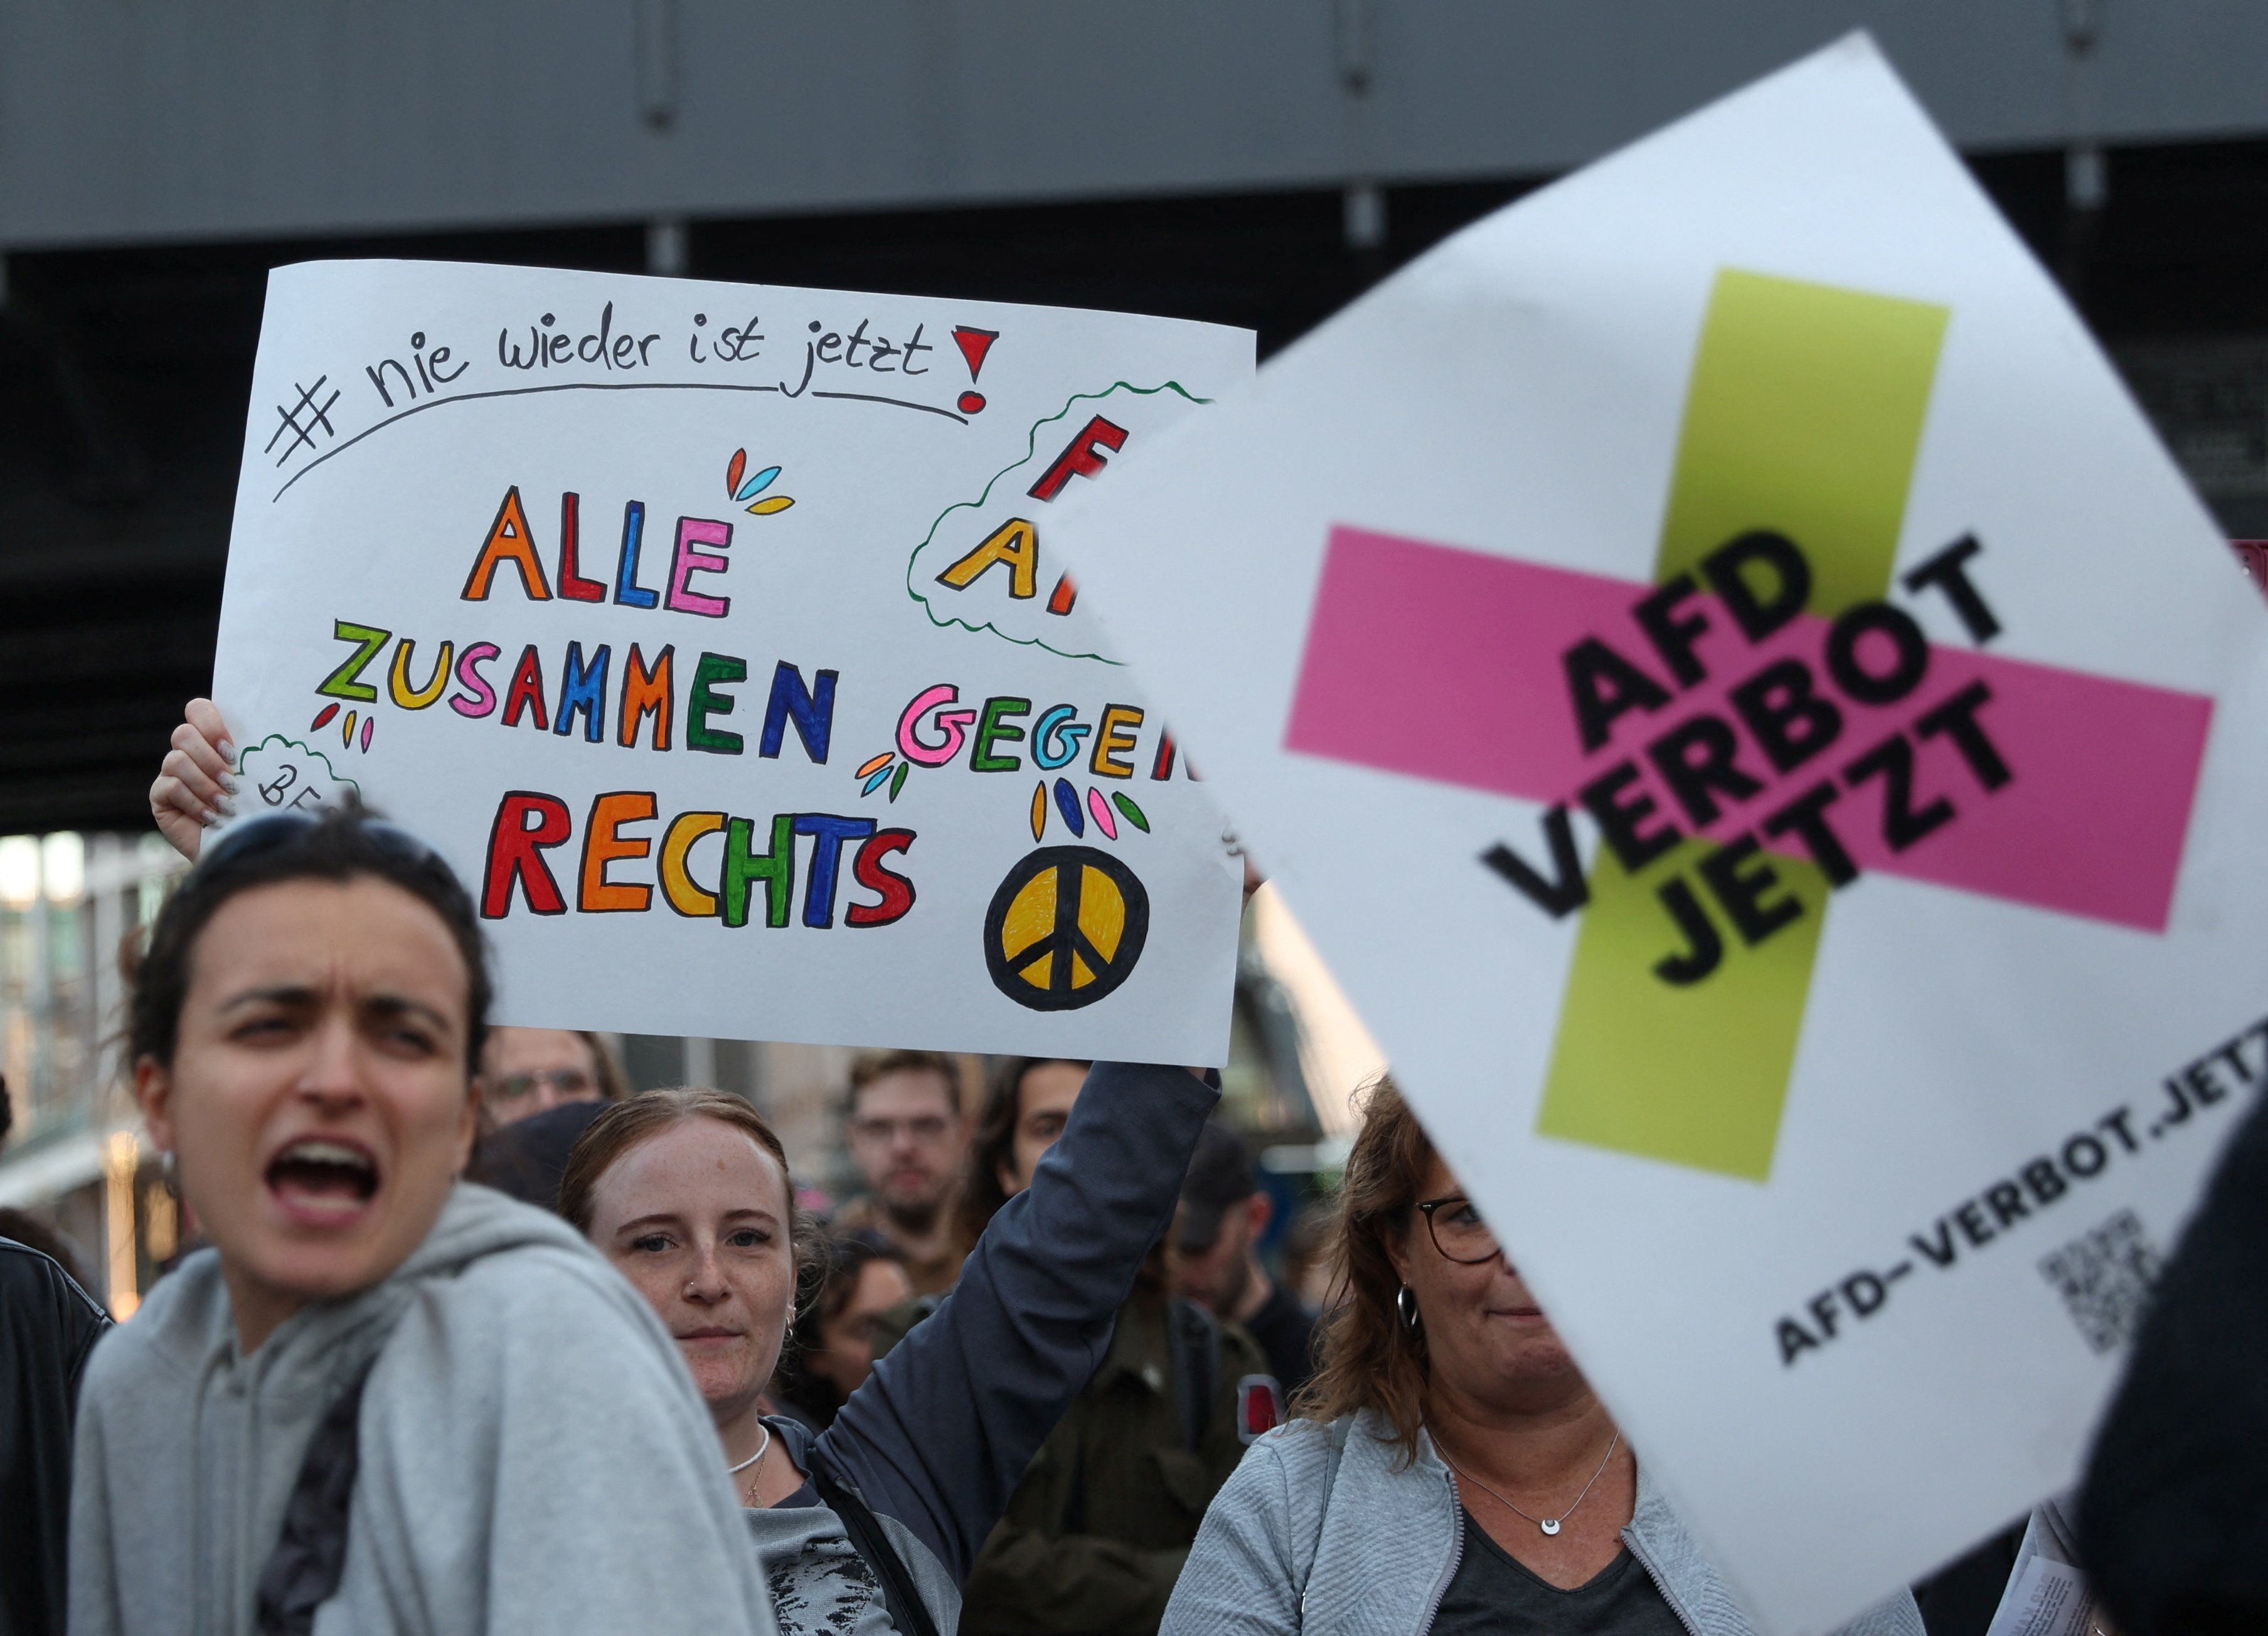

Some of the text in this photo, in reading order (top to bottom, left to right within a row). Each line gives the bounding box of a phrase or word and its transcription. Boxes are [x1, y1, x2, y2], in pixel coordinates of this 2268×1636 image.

[365, 331, 470, 408] nie
[498, 300, 662, 371] wieder
[690, 313, 766, 363] ist
[460, 484, 735, 619] ALLE
[315, 618, 840, 765] ZUSAMMEN
[1560, 528, 1813, 756] AFD
[1475, 529, 2004, 921] VERBOT
[480, 789, 918, 928] RECHTS
[1649, 679, 2016, 989] JETZT
